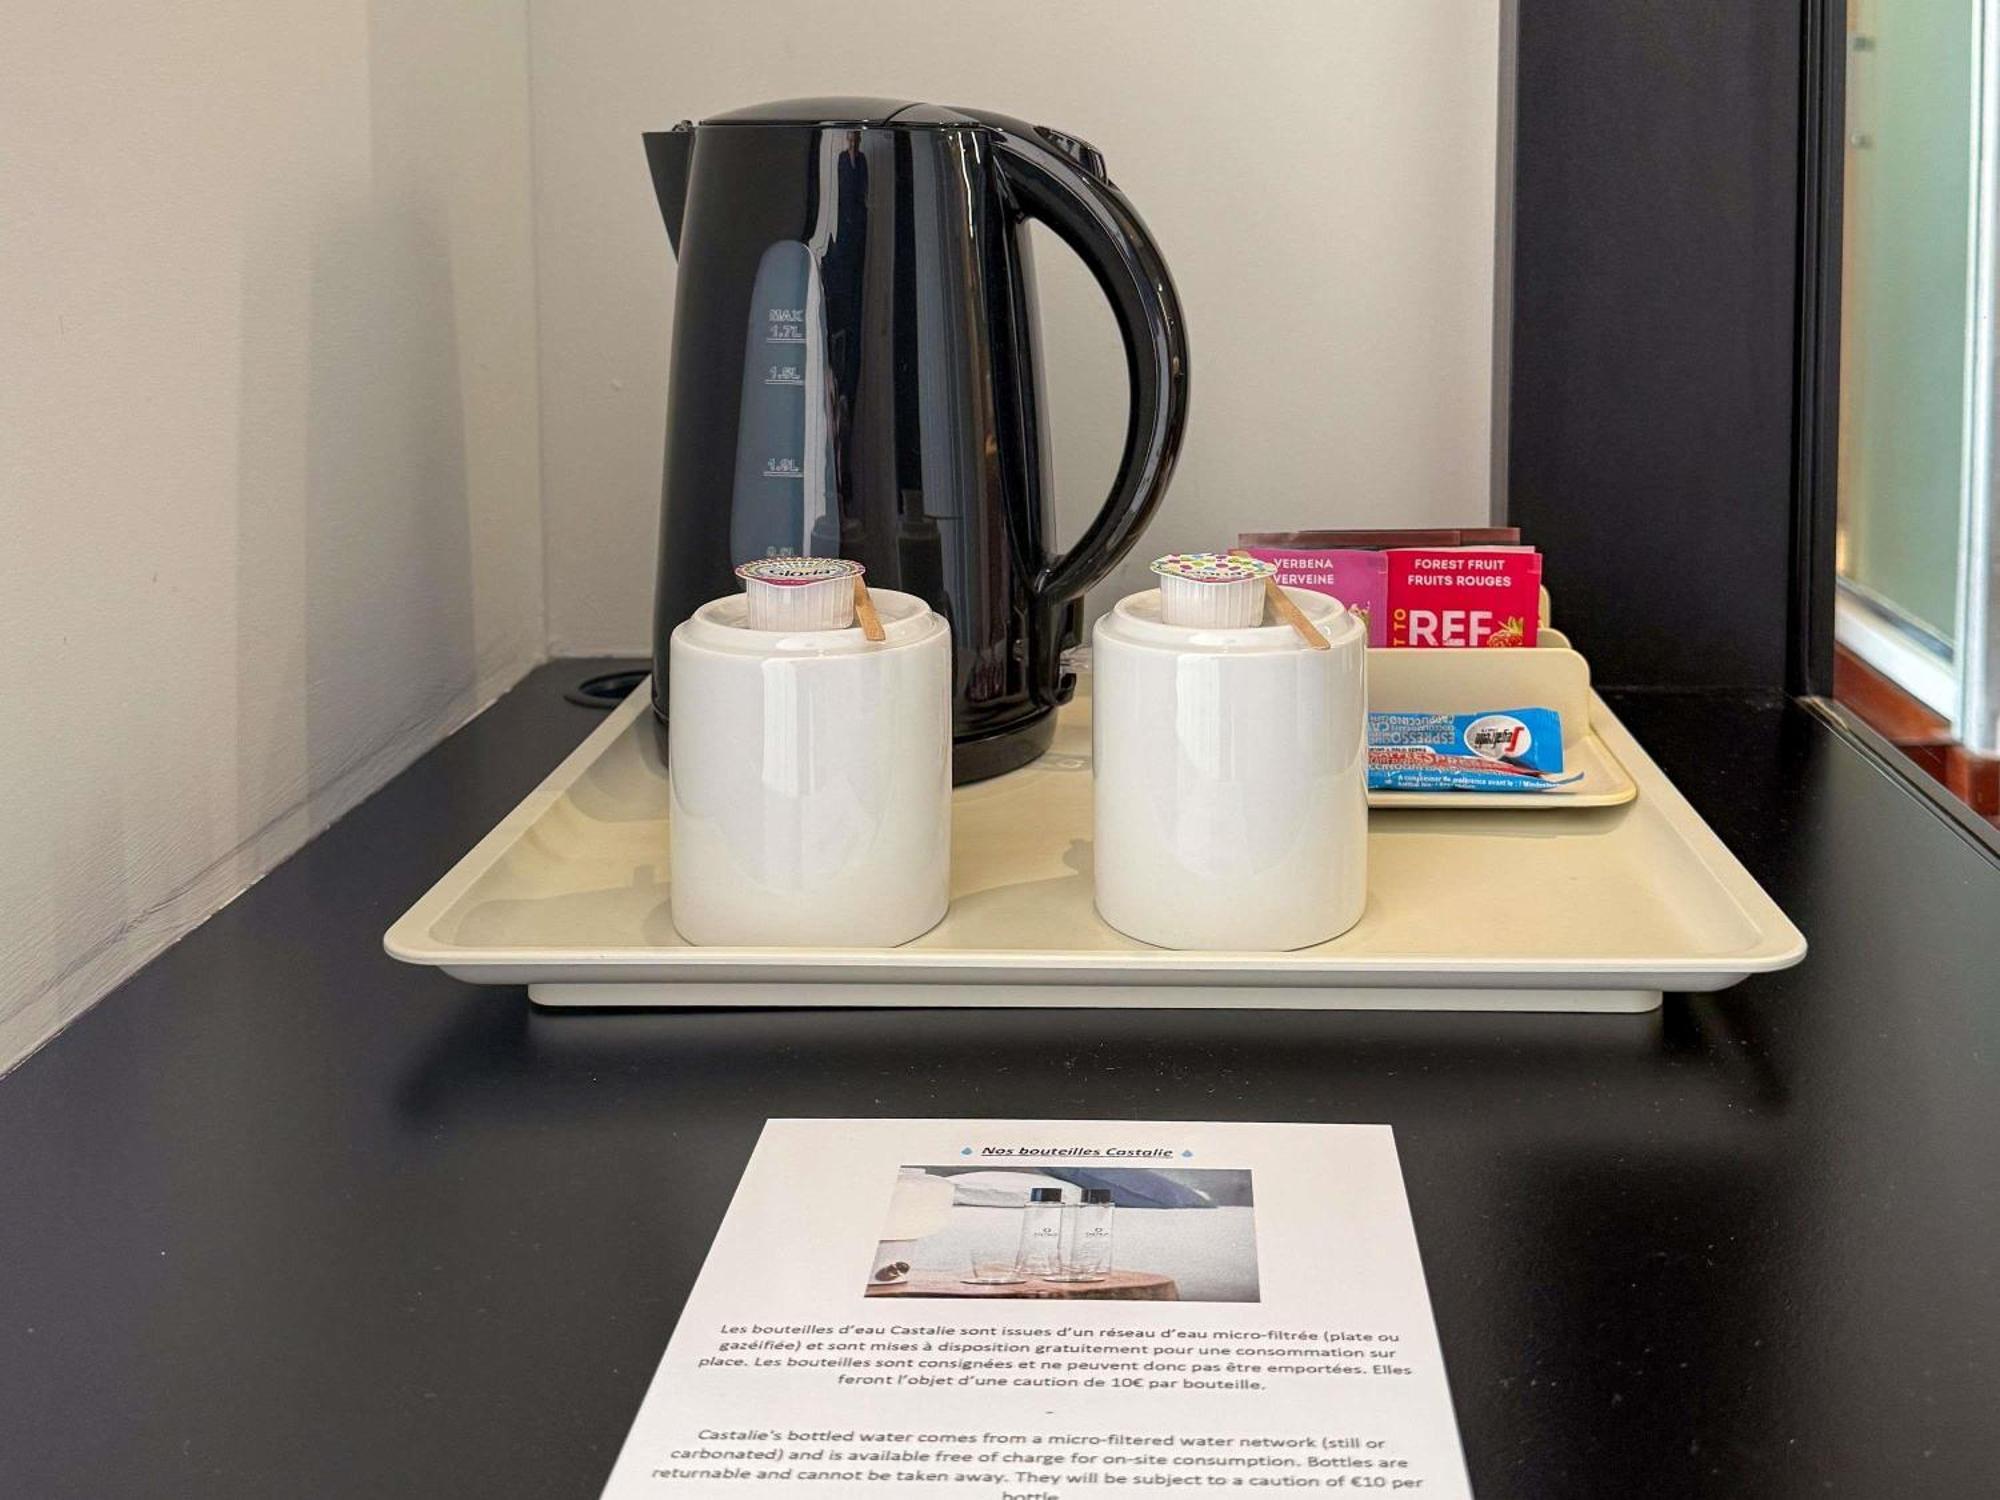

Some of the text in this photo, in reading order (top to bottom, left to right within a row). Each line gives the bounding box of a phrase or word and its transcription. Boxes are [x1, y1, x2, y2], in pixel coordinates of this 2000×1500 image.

[770, 309, 803, 321] MAX
[771, 325, 802, 337] 1.7L
[1274, 559, 1333, 569] VERBENA
[1415, 559, 1505, 570] FOREST FRUIT
[1274, 574, 1334, 585] VERVEINE
[1407, 576, 1511, 588] FRUITS ROUGES
[1393, 609, 1406, 631] TO
[1408, 610, 1493, 647] REF
[1391, 732, 1455, 745] ESPRESSO
[981, 1147, 1173, 1157] Nos bouteilles Castalie
[720, 1324, 747, 1334] Les
[752, 1324, 834, 1334] bouteilles
[838, 1325, 885, 1334] d'eau
[890, 1326, 956, 1335] Castalie
[960, 1327, 997, 1335] sont
[1002, 1327, 1052, 1336] issues
[1056, 1327, 1094, 1337] d'un
[1100, 1328, 1155, 1337] réseau
[1160, 1329, 1207, 1338] d'eau
[1213, 1330, 1318, 1340] micro-filtrée
[1324, 1331, 1373, 1343] (plate
[718, 1340, 801, 1352] gazéifiée)
[806, 1342, 824, 1350] et
[827, 1342, 866, 1351] sont
[870, 1342, 918, 1351] mises
[922, 1342, 932, 1351] à
[938, 1342, 1030, 1353] disposition
[1034, 1344, 1148, 1355] gratuitement
[1153, 1347, 1194, 1356] pour
[1235, 1347, 1364, 1357] consommation
[1370, 1350, 1396, 1358] sur
[698, 1356, 748, 1368] place.
[754, 1357, 782, 1367] Les
[786, 1357, 870, 1367] bouteilles
[875, 1359, 913, 1368] sont
[918, 1358, 1012, 1370] consignées
[1018, 1361, 1036, 1369] et
[1067, 1362, 1138, 1372] peuvent
[1143, 1361, 1186, 1371] donc
[1192, 1364, 1221, 1373] pas
[1226, 1362, 1261, 1372] être
[1267, 1363, 1367, 1375] emportées.
[1372, 1365, 1412, 1375] Elles
[838, 1374, 1266, 1390] feront l'objet d'une caution de 10€ par bouteille.
[698, 1429, 1385, 1450] Castalie's bottled water comes from a micro-filtered water network (still or
[670, 1448, 1408, 1468] carbonated) and is available free of charge for on-site consumption. Bottles are
[652, 1467, 1423, 1490] returnable and cannot be taken away. They will be subject to a caution of €10 per
